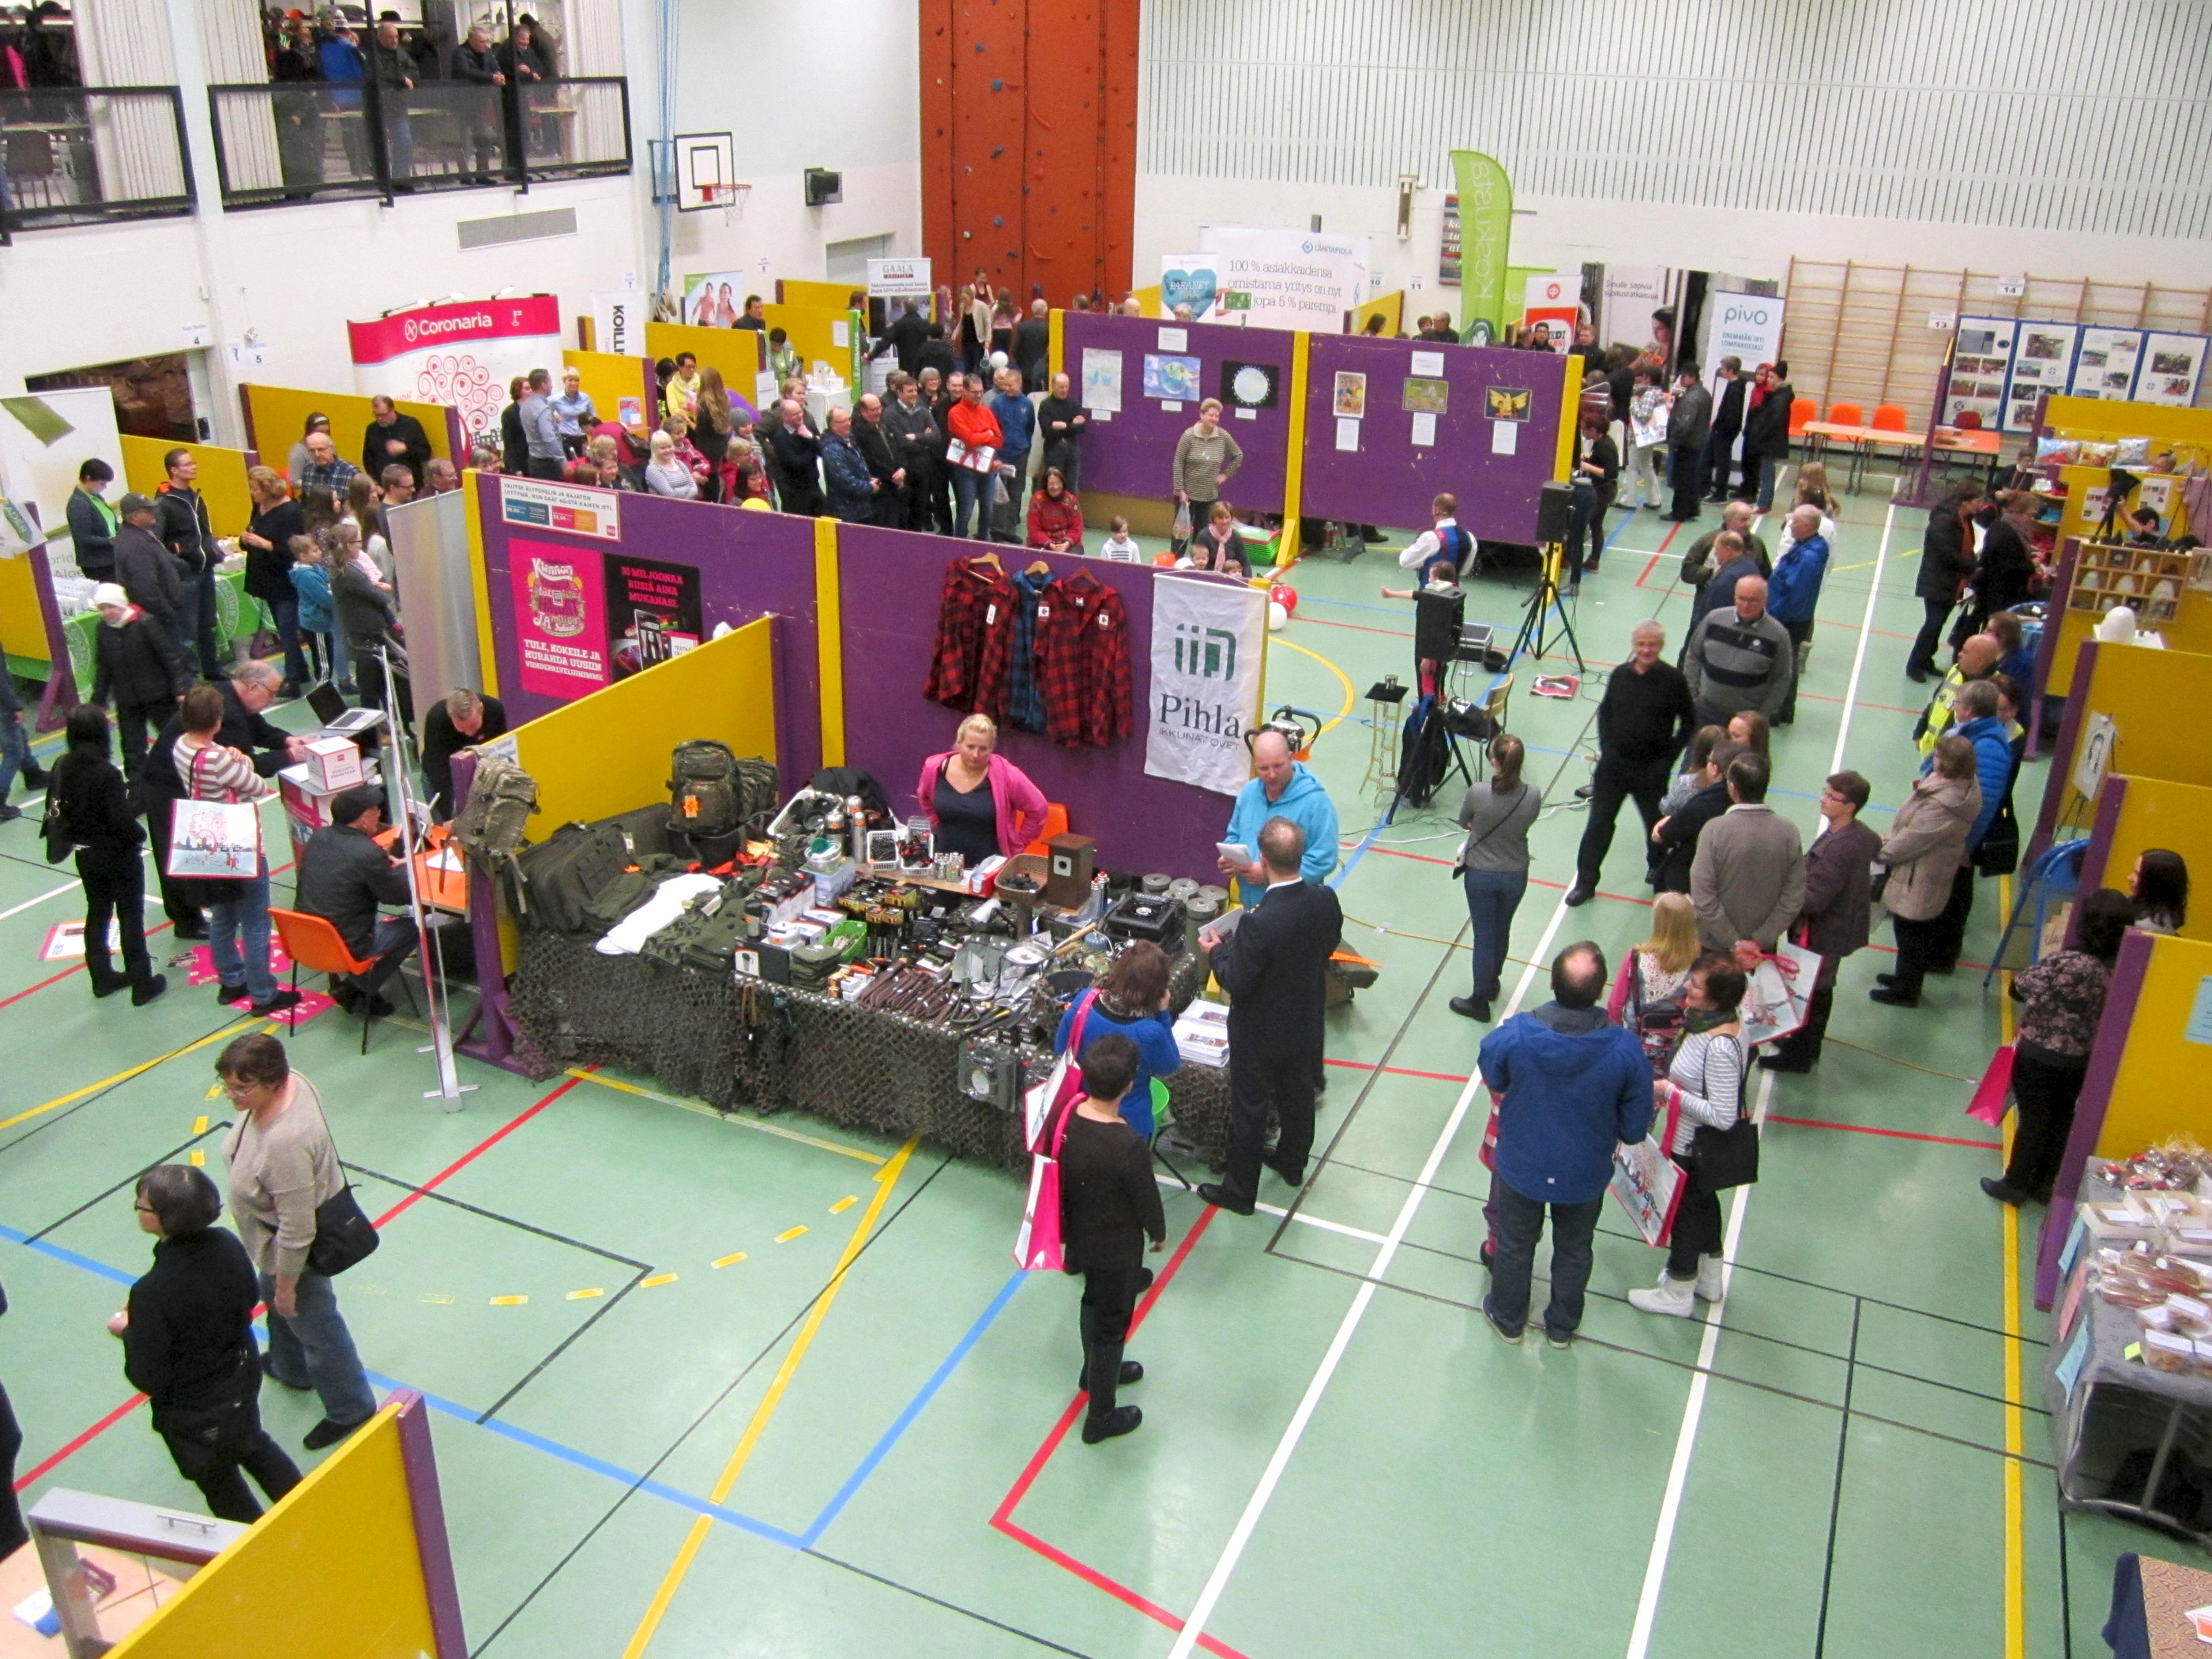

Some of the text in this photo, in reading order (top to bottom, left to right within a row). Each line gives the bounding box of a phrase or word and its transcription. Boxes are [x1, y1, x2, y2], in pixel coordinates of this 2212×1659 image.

[1229, 260, 1333, 278] 100 % asiakkaidensa
[1228, 277, 1342, 299] omistama yritys on nyt
[1252, 295, 1276, 308] jopa
[1278, 295, 1285, 307] 5
[1288, 296, 1296, 308] %
[419, 312, 492, 336] Coronaria
[1725, 304, 1767, 325] pivo
[613, 305, 625, 355] KOILLI
[256, 355, 261, 363] 5
[525, 649, 602, 672] HURAHDA UUSIIN
[551, 644, 589, 657] KOKEILE
[590, 650, 601, 661] JA
[1159, 693, 1241, 739] Pihla
[1159, 727, 1240, 751] IKKUNAT OVET
